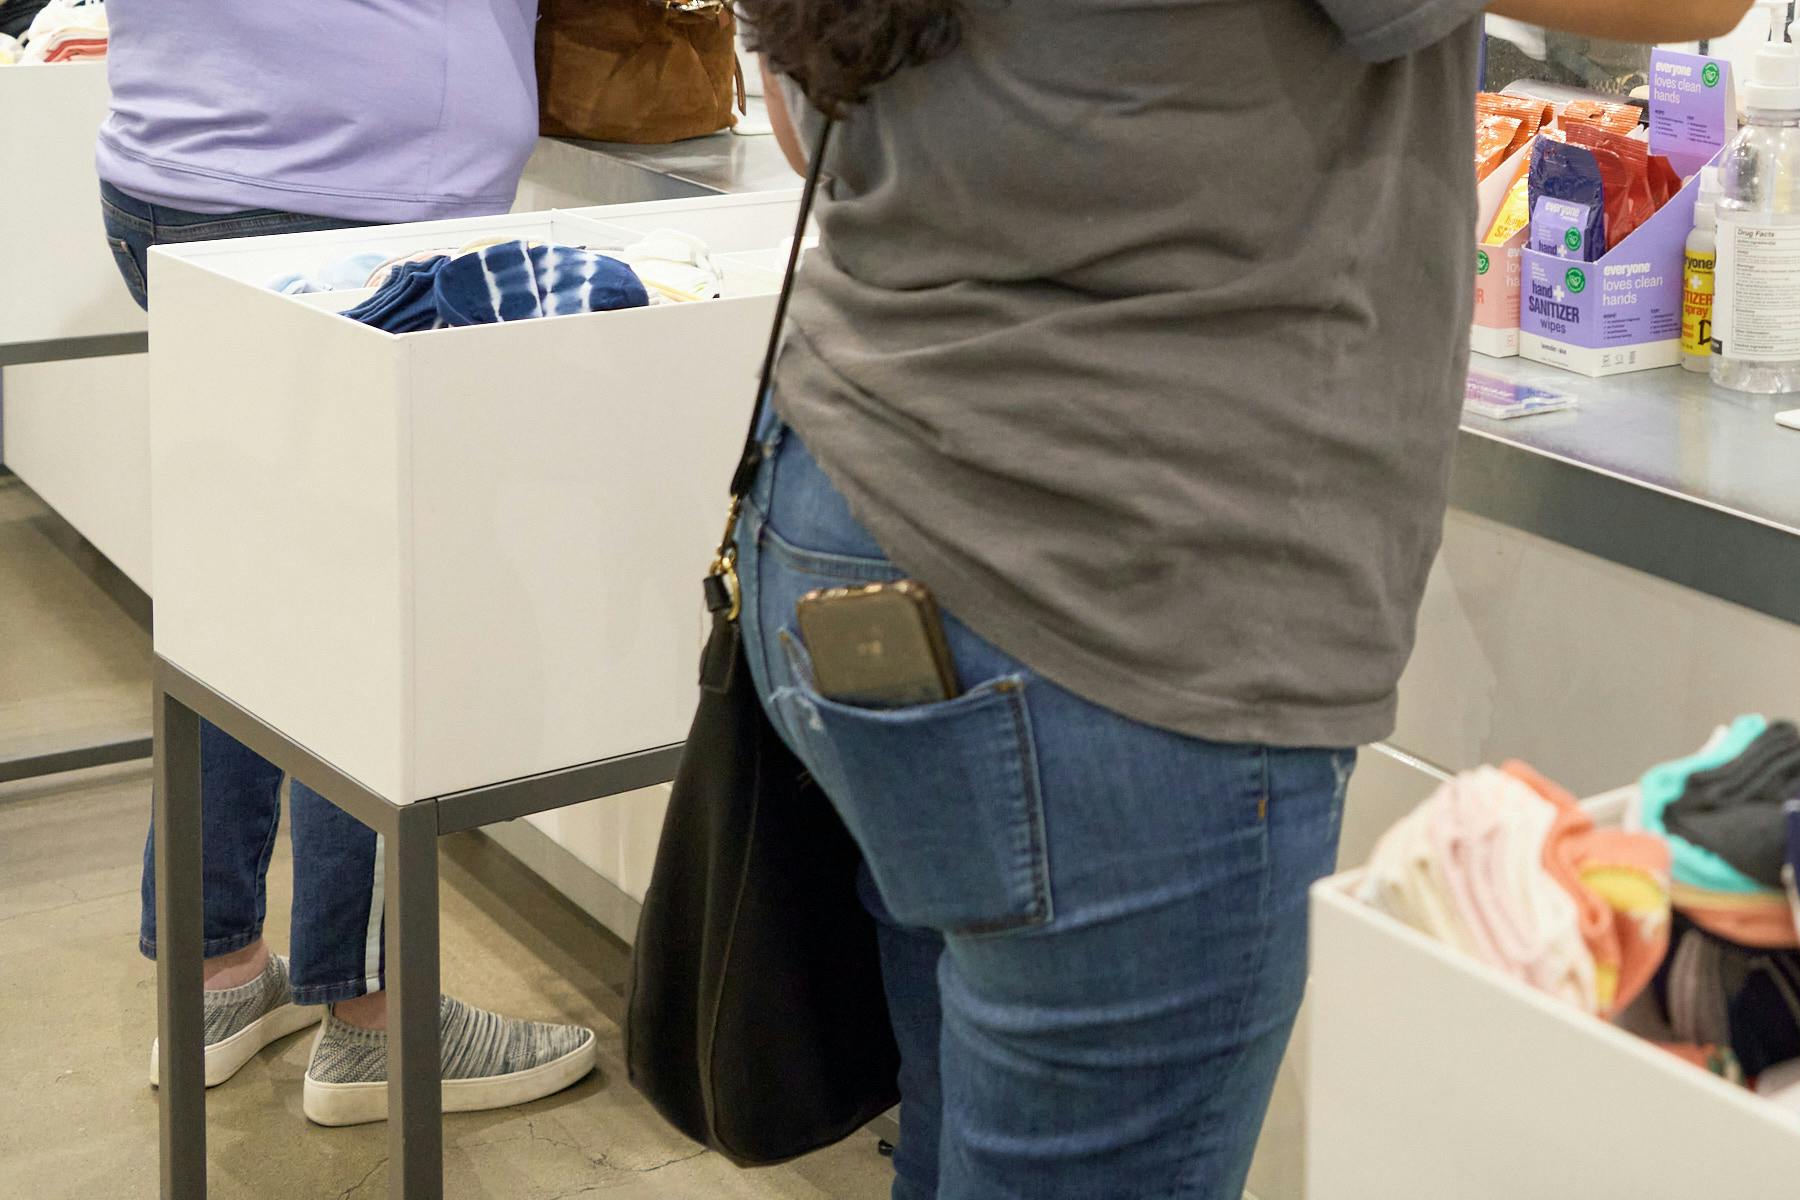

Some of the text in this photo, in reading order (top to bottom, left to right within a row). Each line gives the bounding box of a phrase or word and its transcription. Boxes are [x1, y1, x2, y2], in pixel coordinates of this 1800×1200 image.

[1655, 62, 1693, 77] everyone
[1655, 74, 1702, 94] loves clean
[1654, 87, 1681, 104] hands
[1545, 201, 1580, 218] everyone
[1603, 262, 1652, 277] everyone
[1532, 280, 1553, 299] hand
[1603, 275, 1664, 291] loves clean
[1603, 291, 1638, 307] hands
[1528, 295, 1580, 324] SANITIZER
[1540, 318, 1567, 335] wipes
